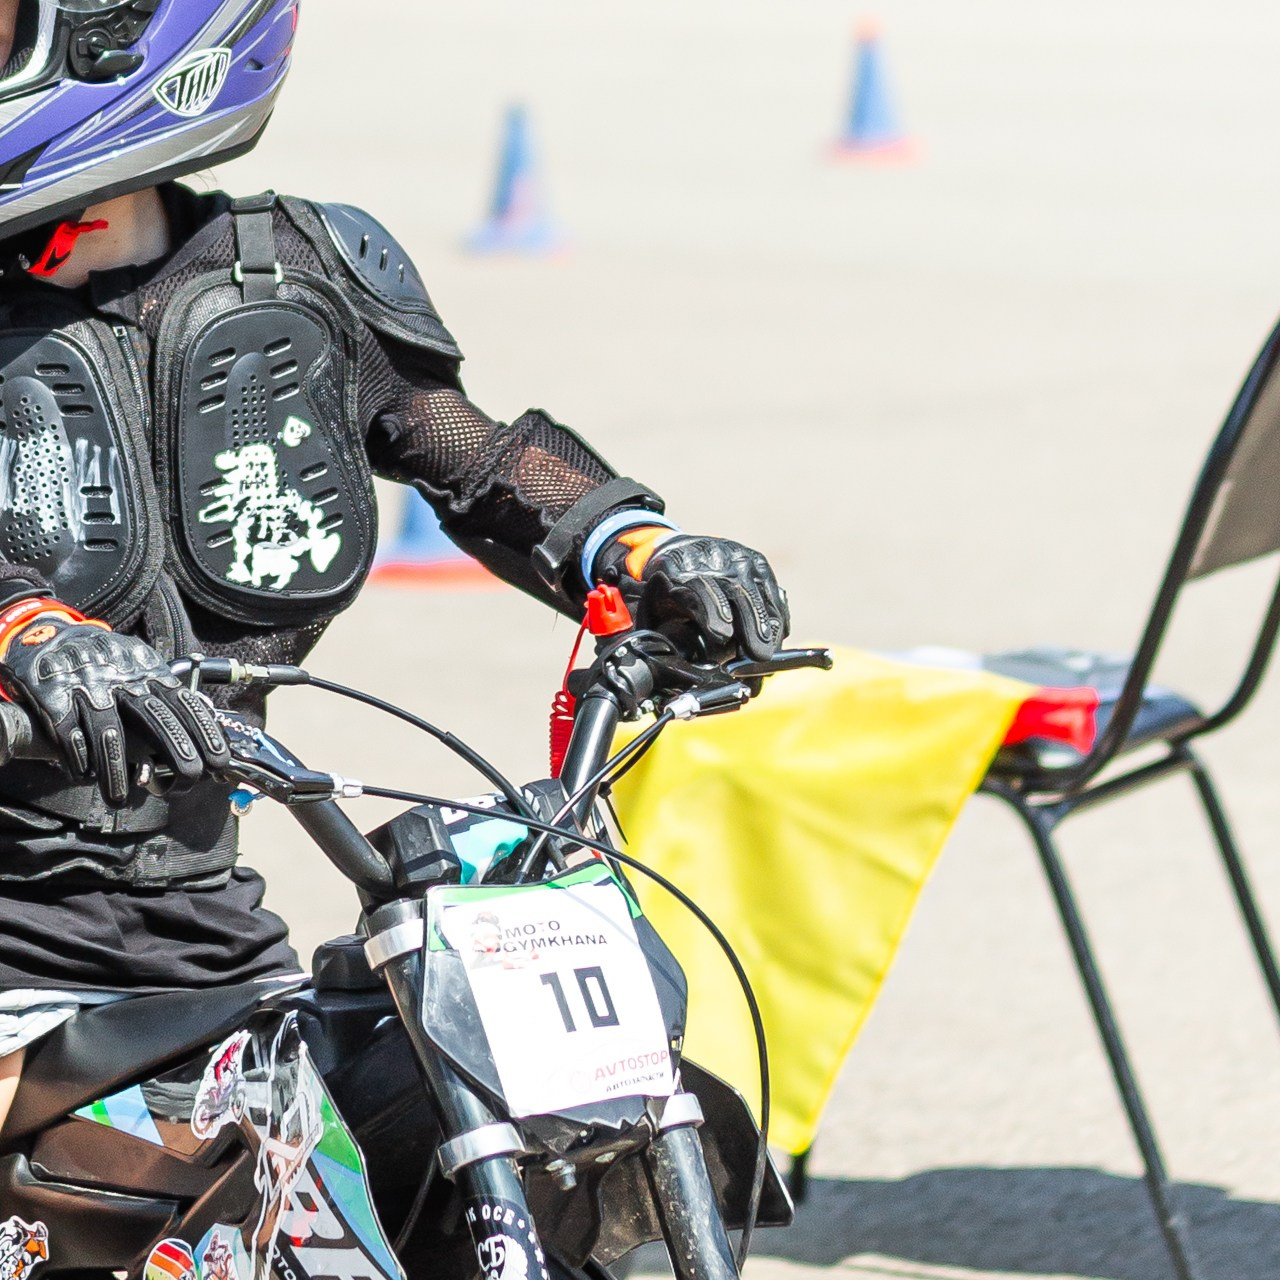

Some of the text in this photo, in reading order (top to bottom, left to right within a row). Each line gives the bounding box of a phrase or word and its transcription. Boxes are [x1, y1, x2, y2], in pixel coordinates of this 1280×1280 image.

[505, 920, 561, 939] MOO
[503, 934, 608, 953] GYMKHANA
[539, 966, 620, 1033] 10
[595, 1050, 668, 1081] AVTOSTOP
